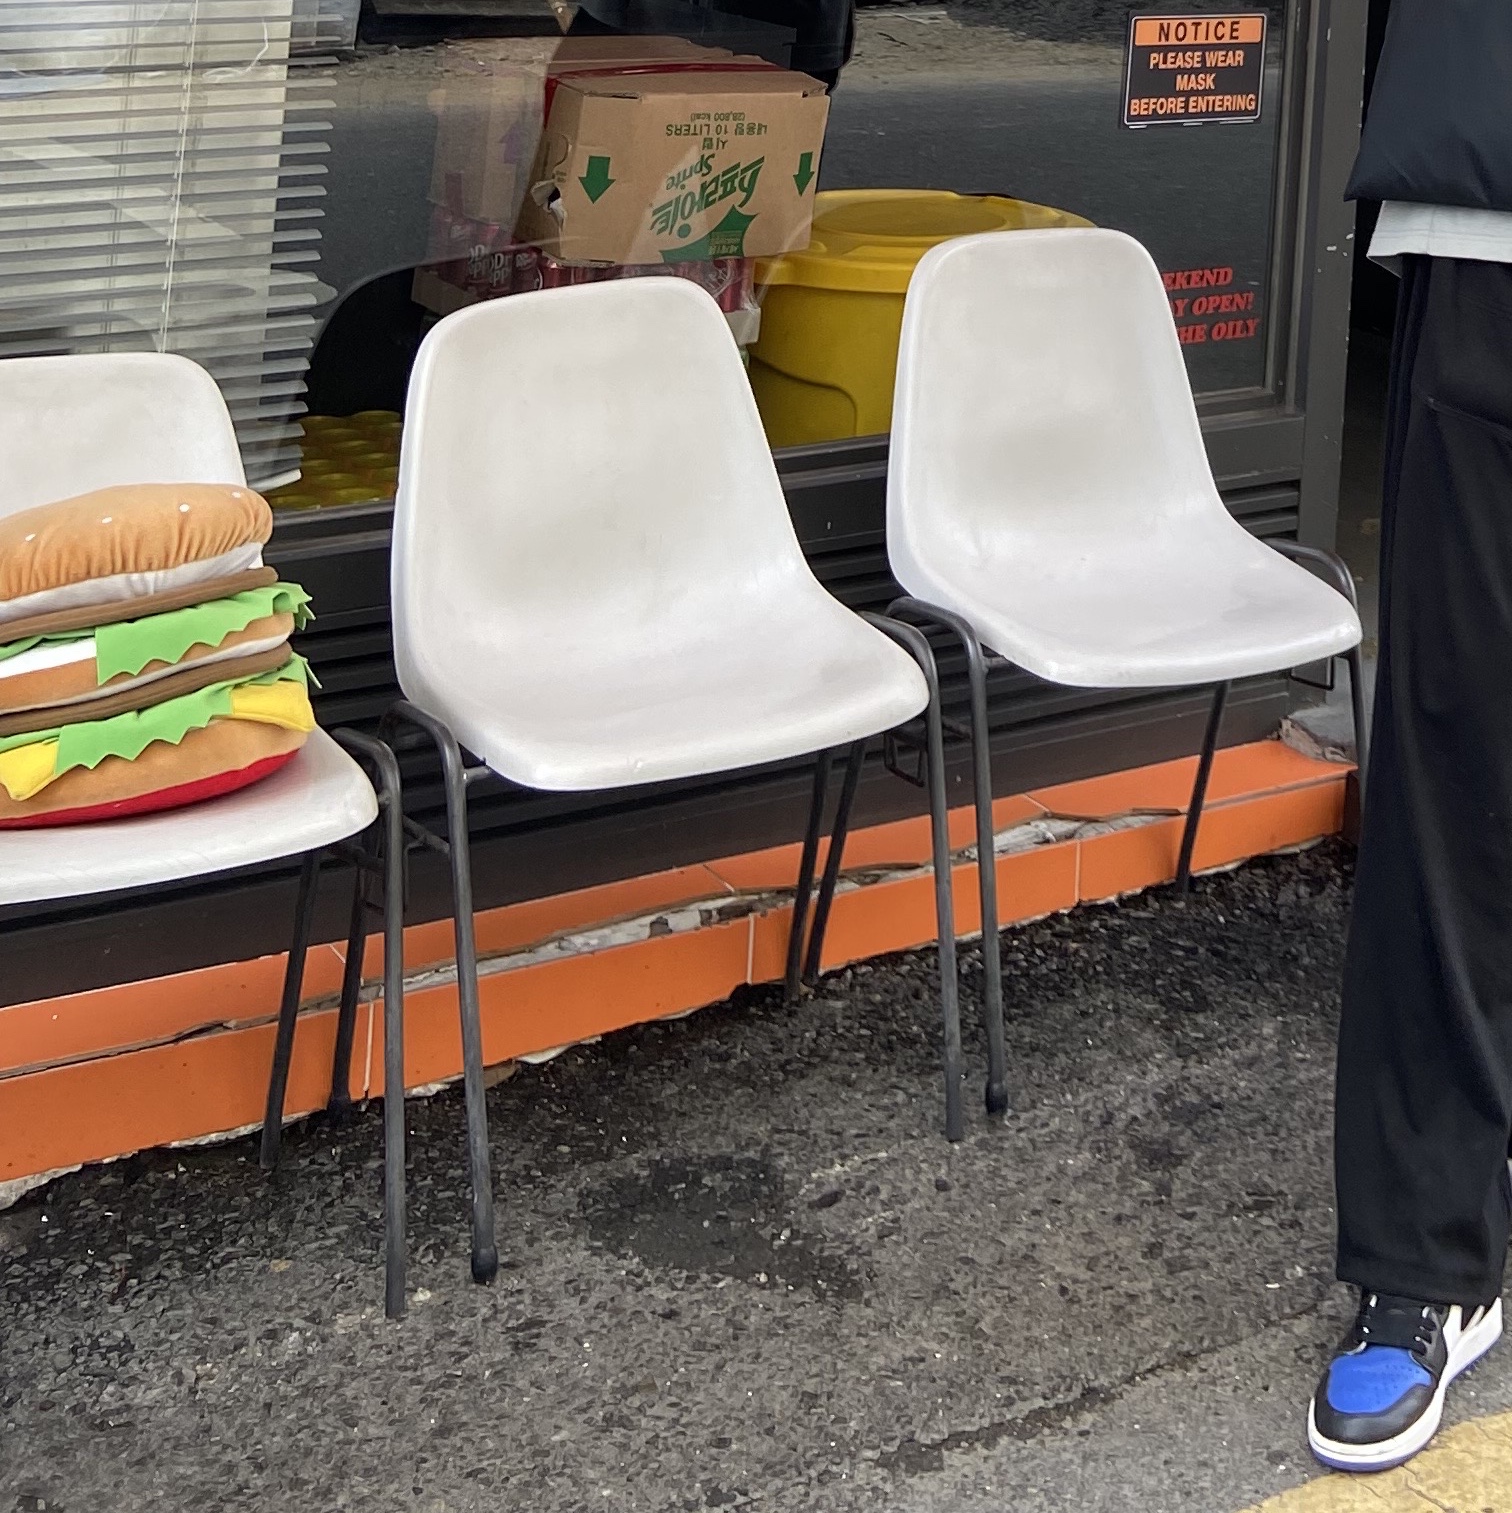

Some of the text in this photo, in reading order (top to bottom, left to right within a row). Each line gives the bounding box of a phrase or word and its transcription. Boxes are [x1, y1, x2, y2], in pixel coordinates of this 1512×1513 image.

[1158, 20, 1241, 42] NOTICE
[1149, 50, 1245, 69] PLEASE WEAR
[1175, 73, 1216, 91] MASK
[1129, 94, 1256, 116] BEFORE ENTERING
[666, 123, 768, 136] 내용량 10 LITERS
[702, 137, 729, 151] 시럽
[666, 153, 716, 190] Sprite
[649, 155, 765, 237] 스프라이트
[1162, 267, 1234, 291] EKEND
[1191, 292, 1255, 316] OPEN!
[1177, 318, 1260, 344] HE OILY
